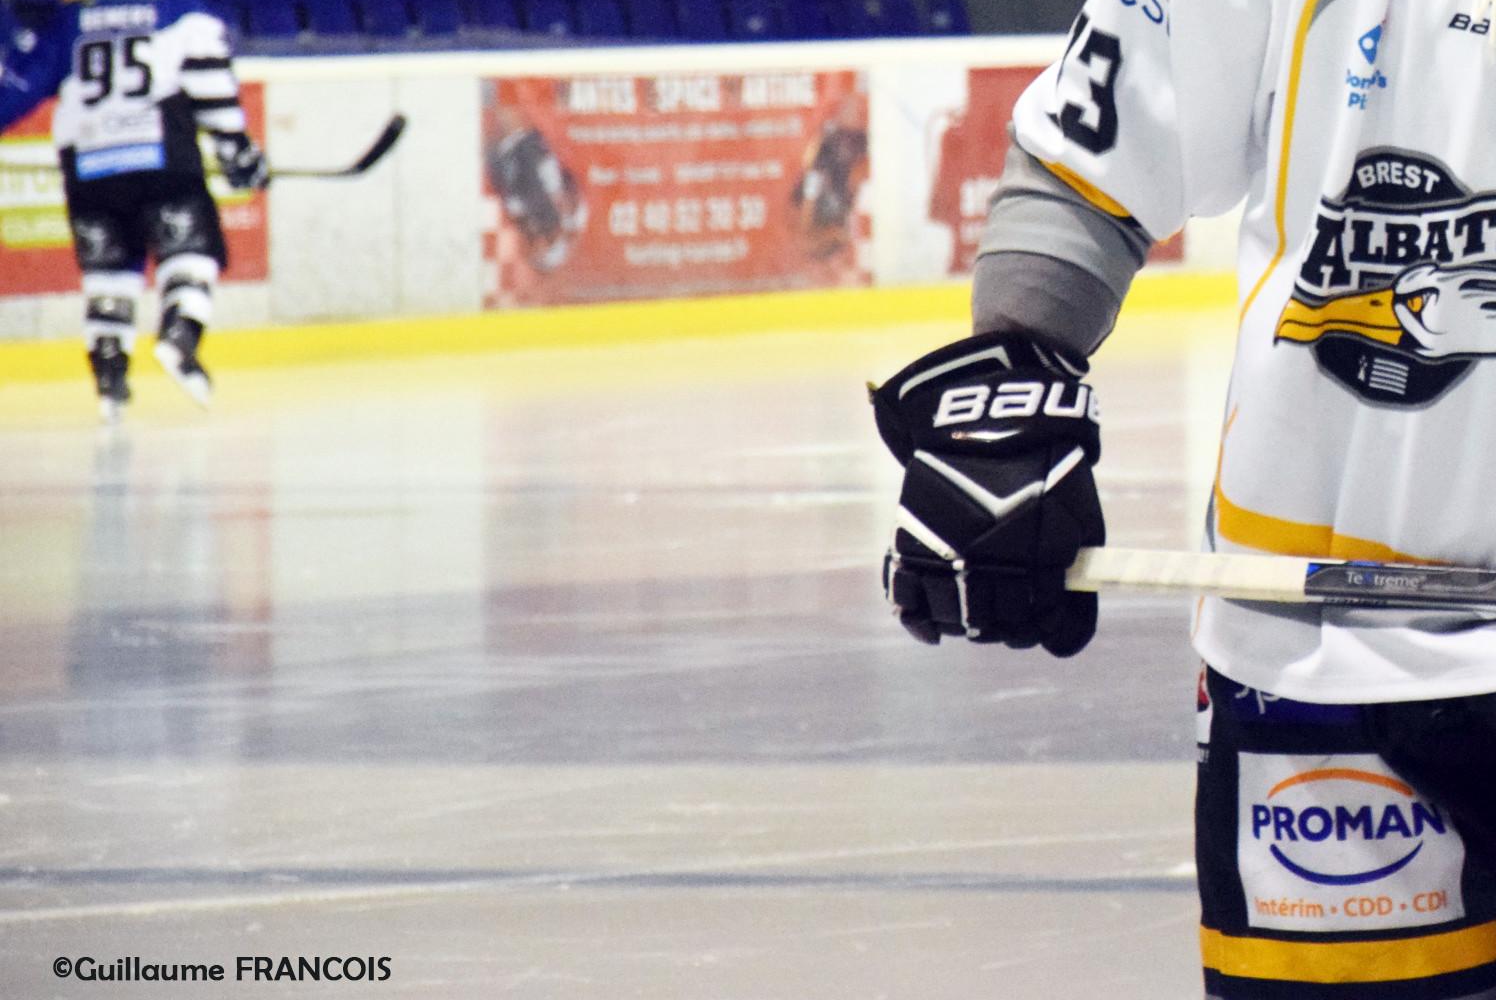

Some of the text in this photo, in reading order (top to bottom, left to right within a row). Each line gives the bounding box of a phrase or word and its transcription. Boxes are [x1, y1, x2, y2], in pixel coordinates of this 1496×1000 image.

[80, 36, 152, 107] 95
[1357, 160, 1440, 194] BREST
[933, 381, 1100, 428] BAU
[1252, 803, 1446, 842] PROMAN
[1344, 896, 1393, 917] CDD
[1413, 891, 1447, 913] CDI
